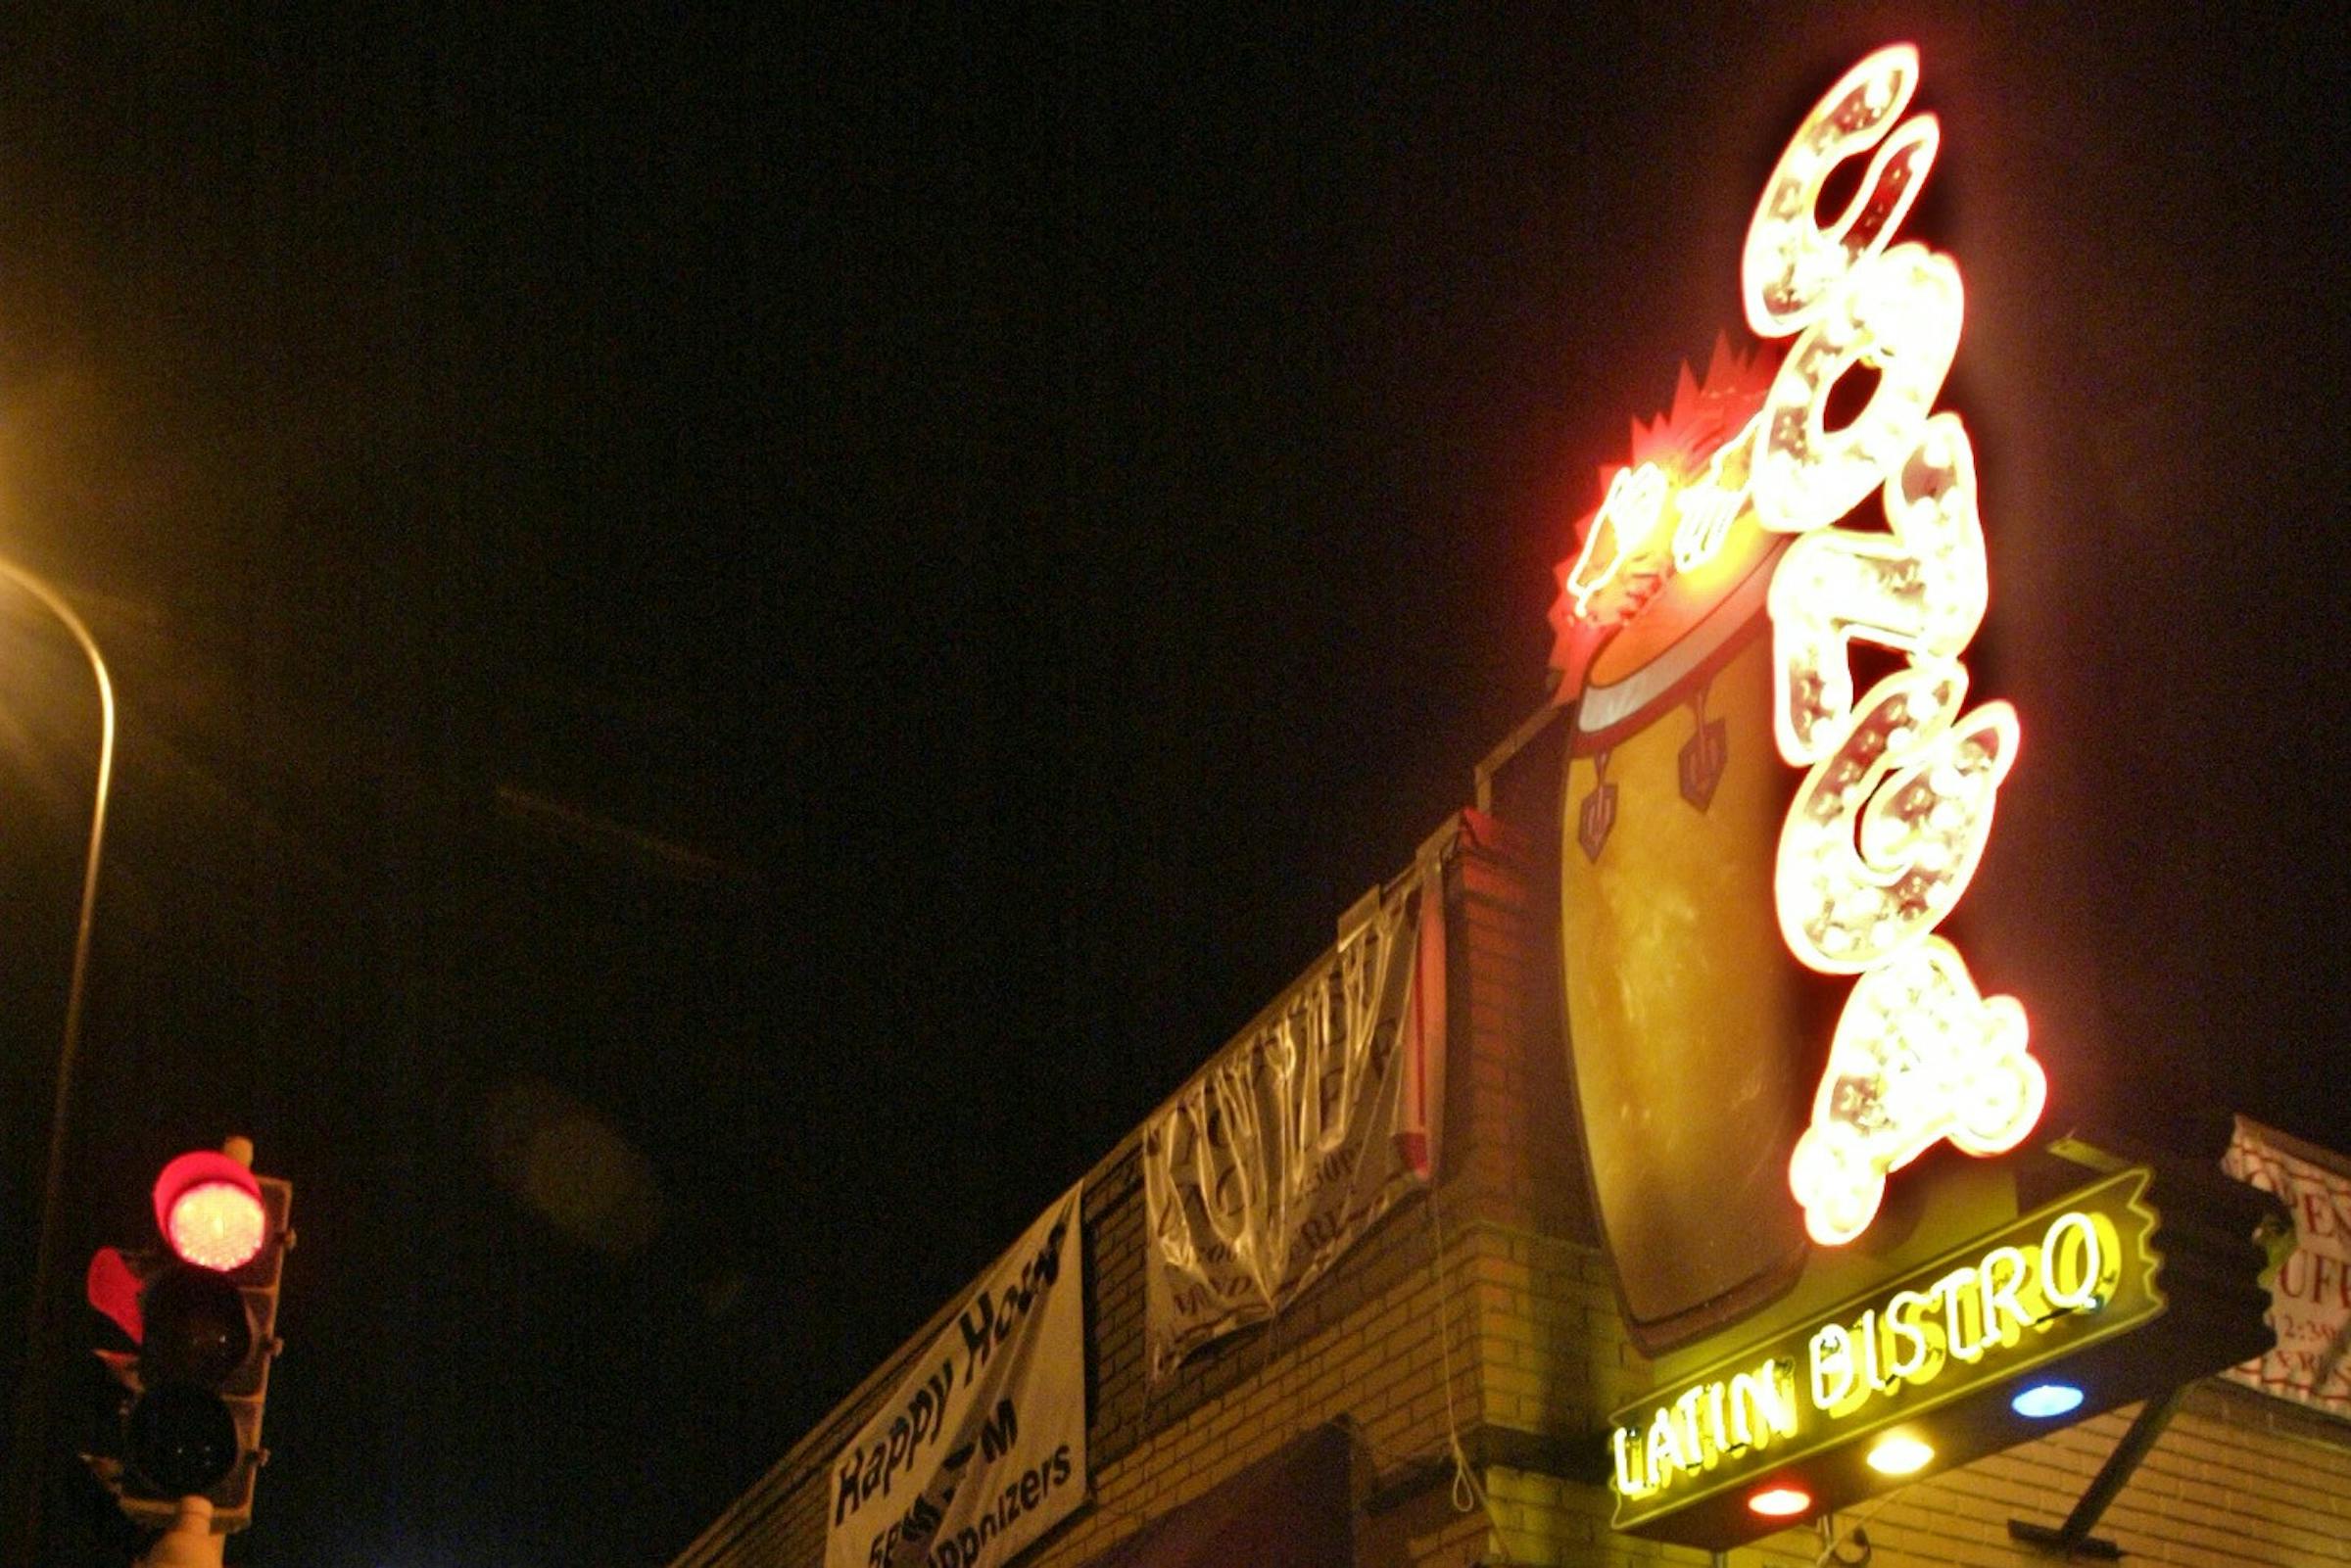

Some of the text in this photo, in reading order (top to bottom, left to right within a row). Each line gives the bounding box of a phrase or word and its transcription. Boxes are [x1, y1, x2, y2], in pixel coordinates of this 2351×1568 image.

[1742, 42, 2047, 1246] CONGA
[835, 1357, 955, 1527] Happy
[1613, 1212, 2121, 1499] LATIN BISTRO
